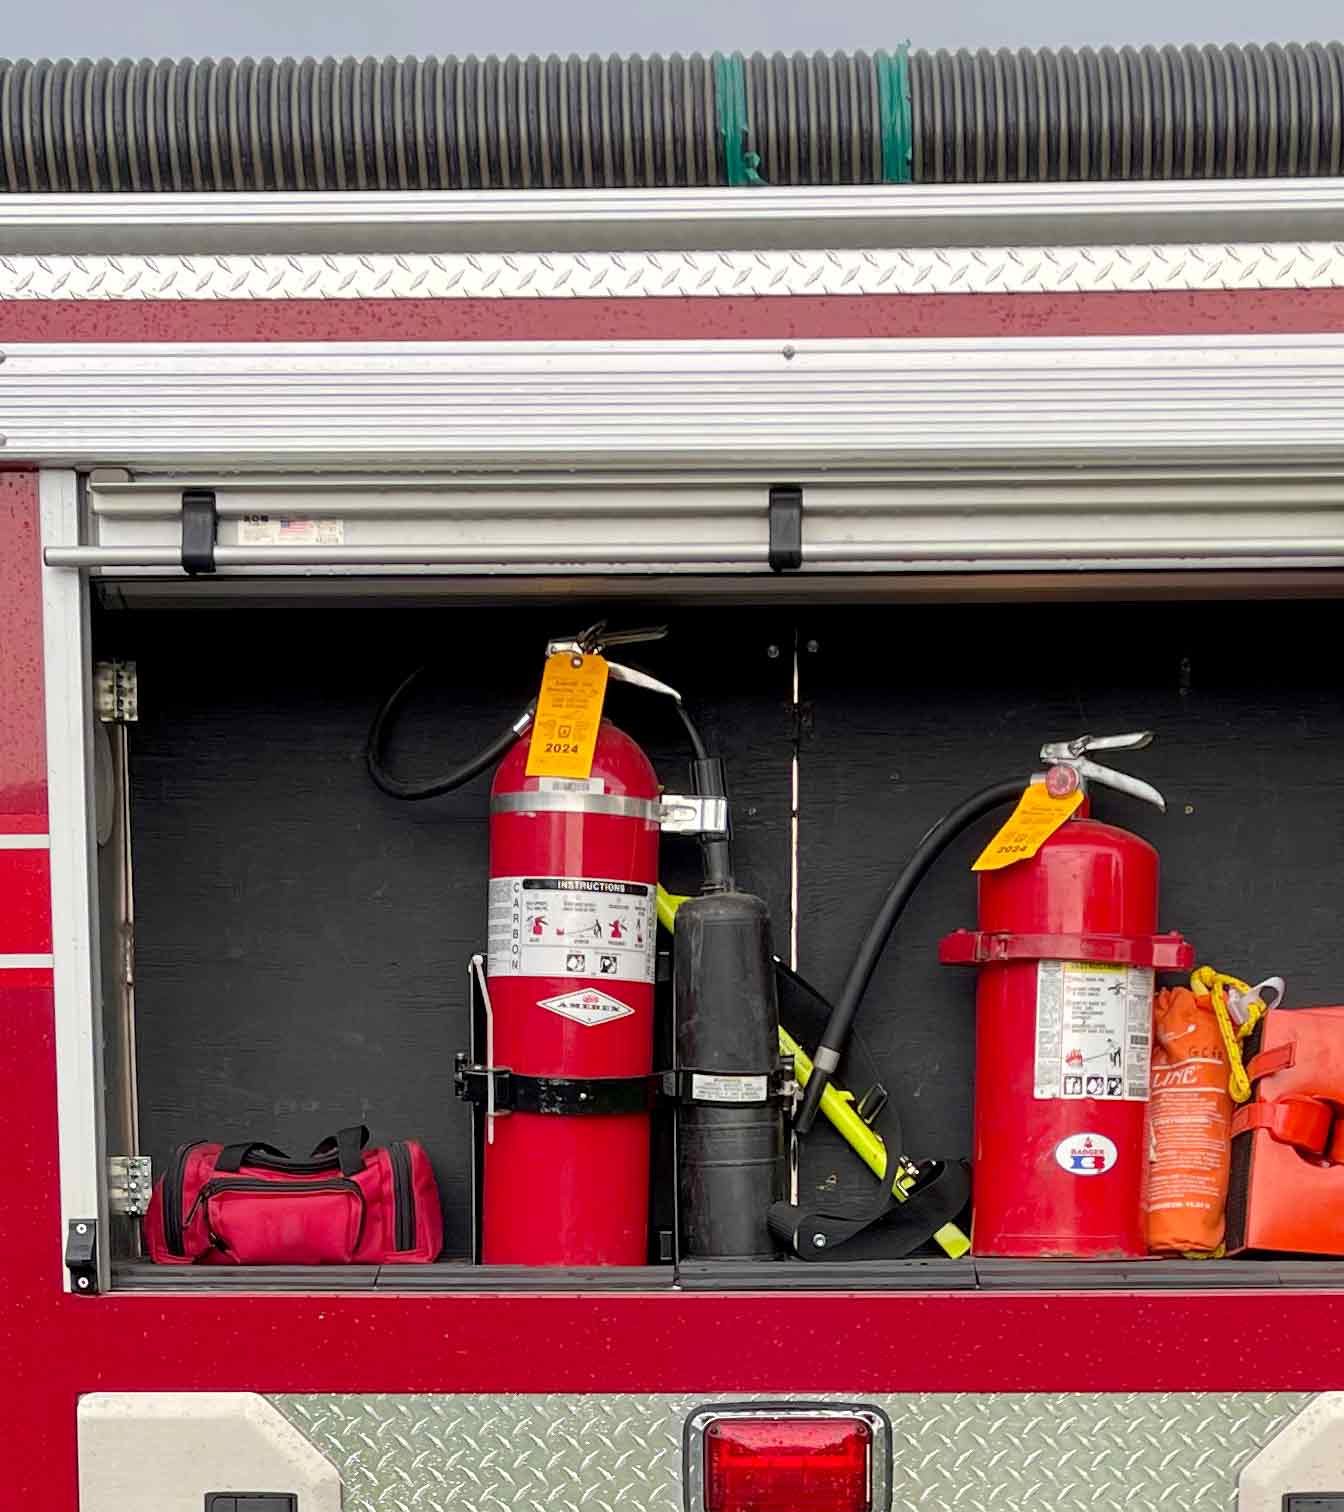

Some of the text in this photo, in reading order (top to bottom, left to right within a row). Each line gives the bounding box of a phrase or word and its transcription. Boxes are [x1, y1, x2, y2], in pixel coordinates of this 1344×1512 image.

[544, 743, 579, 753] 2024
[997, 844, 1028, 854] 2024
[557, 880, 626, 893] INSTRUCTIONS
[511, 882, 521, 970] CARBON
[557, 1002, 620, 1012] AMEREX
[1152, 1065, 1198, 1089] LINE
